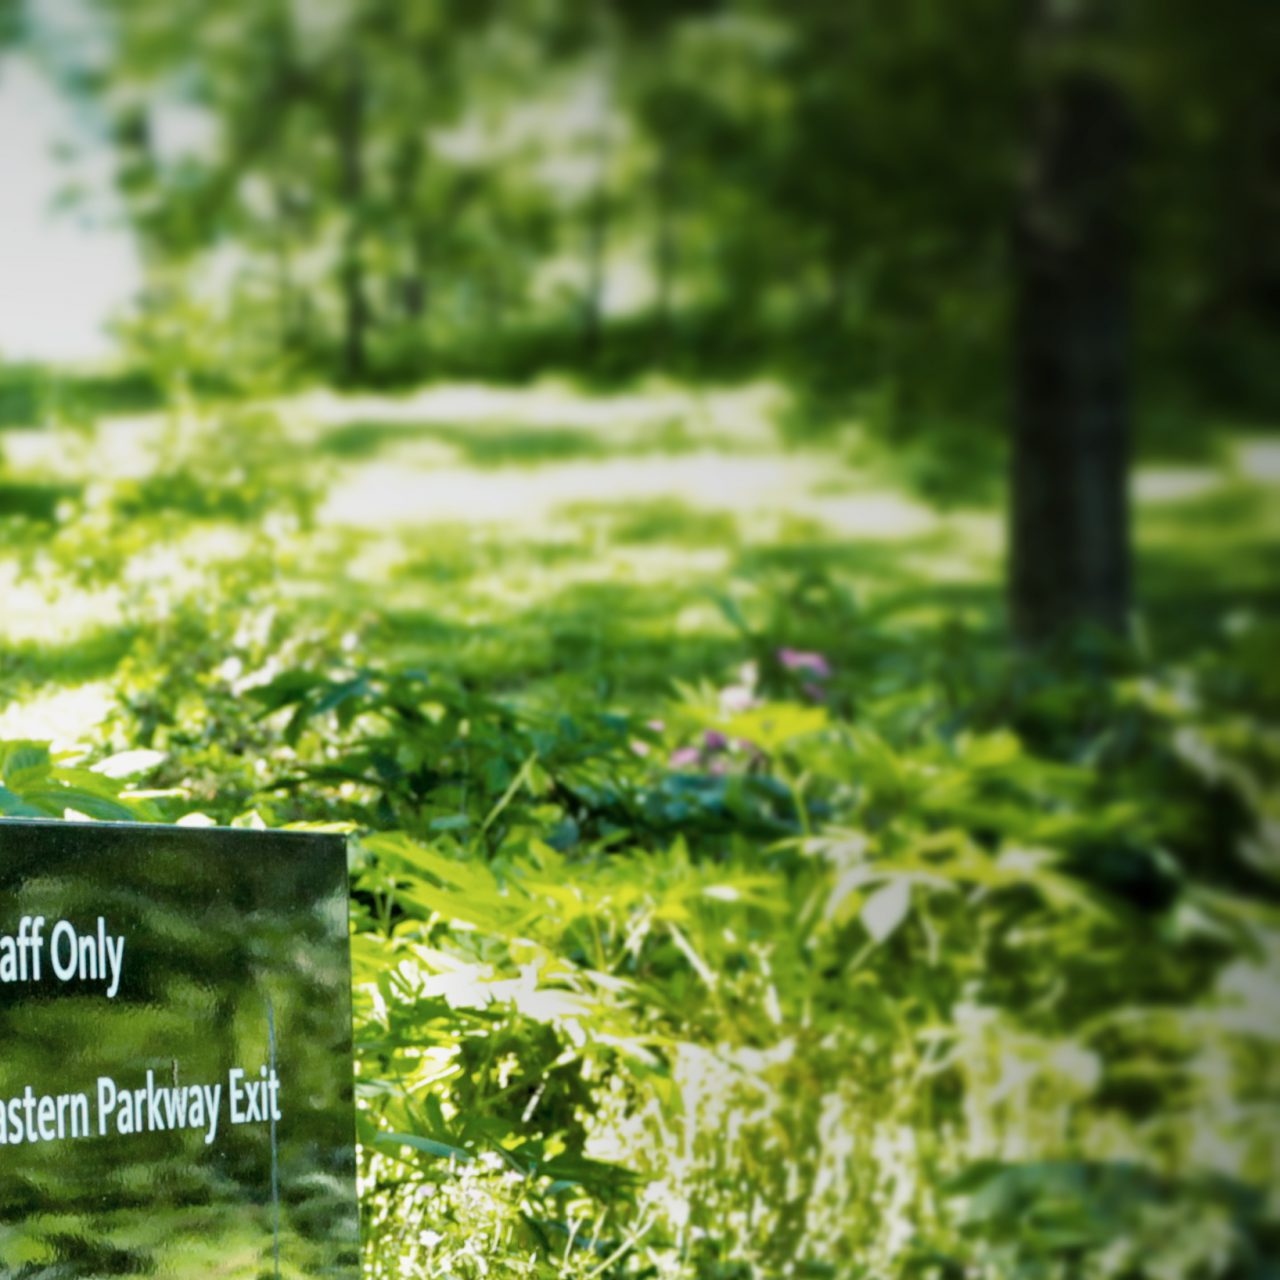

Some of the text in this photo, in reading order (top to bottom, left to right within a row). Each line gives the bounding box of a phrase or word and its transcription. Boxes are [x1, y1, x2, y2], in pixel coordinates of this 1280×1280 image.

[50, 916, 125, 998] Only
[97, 1069, 221, 1144] Parkway
[229, 1065, 282, 1124] Exit
